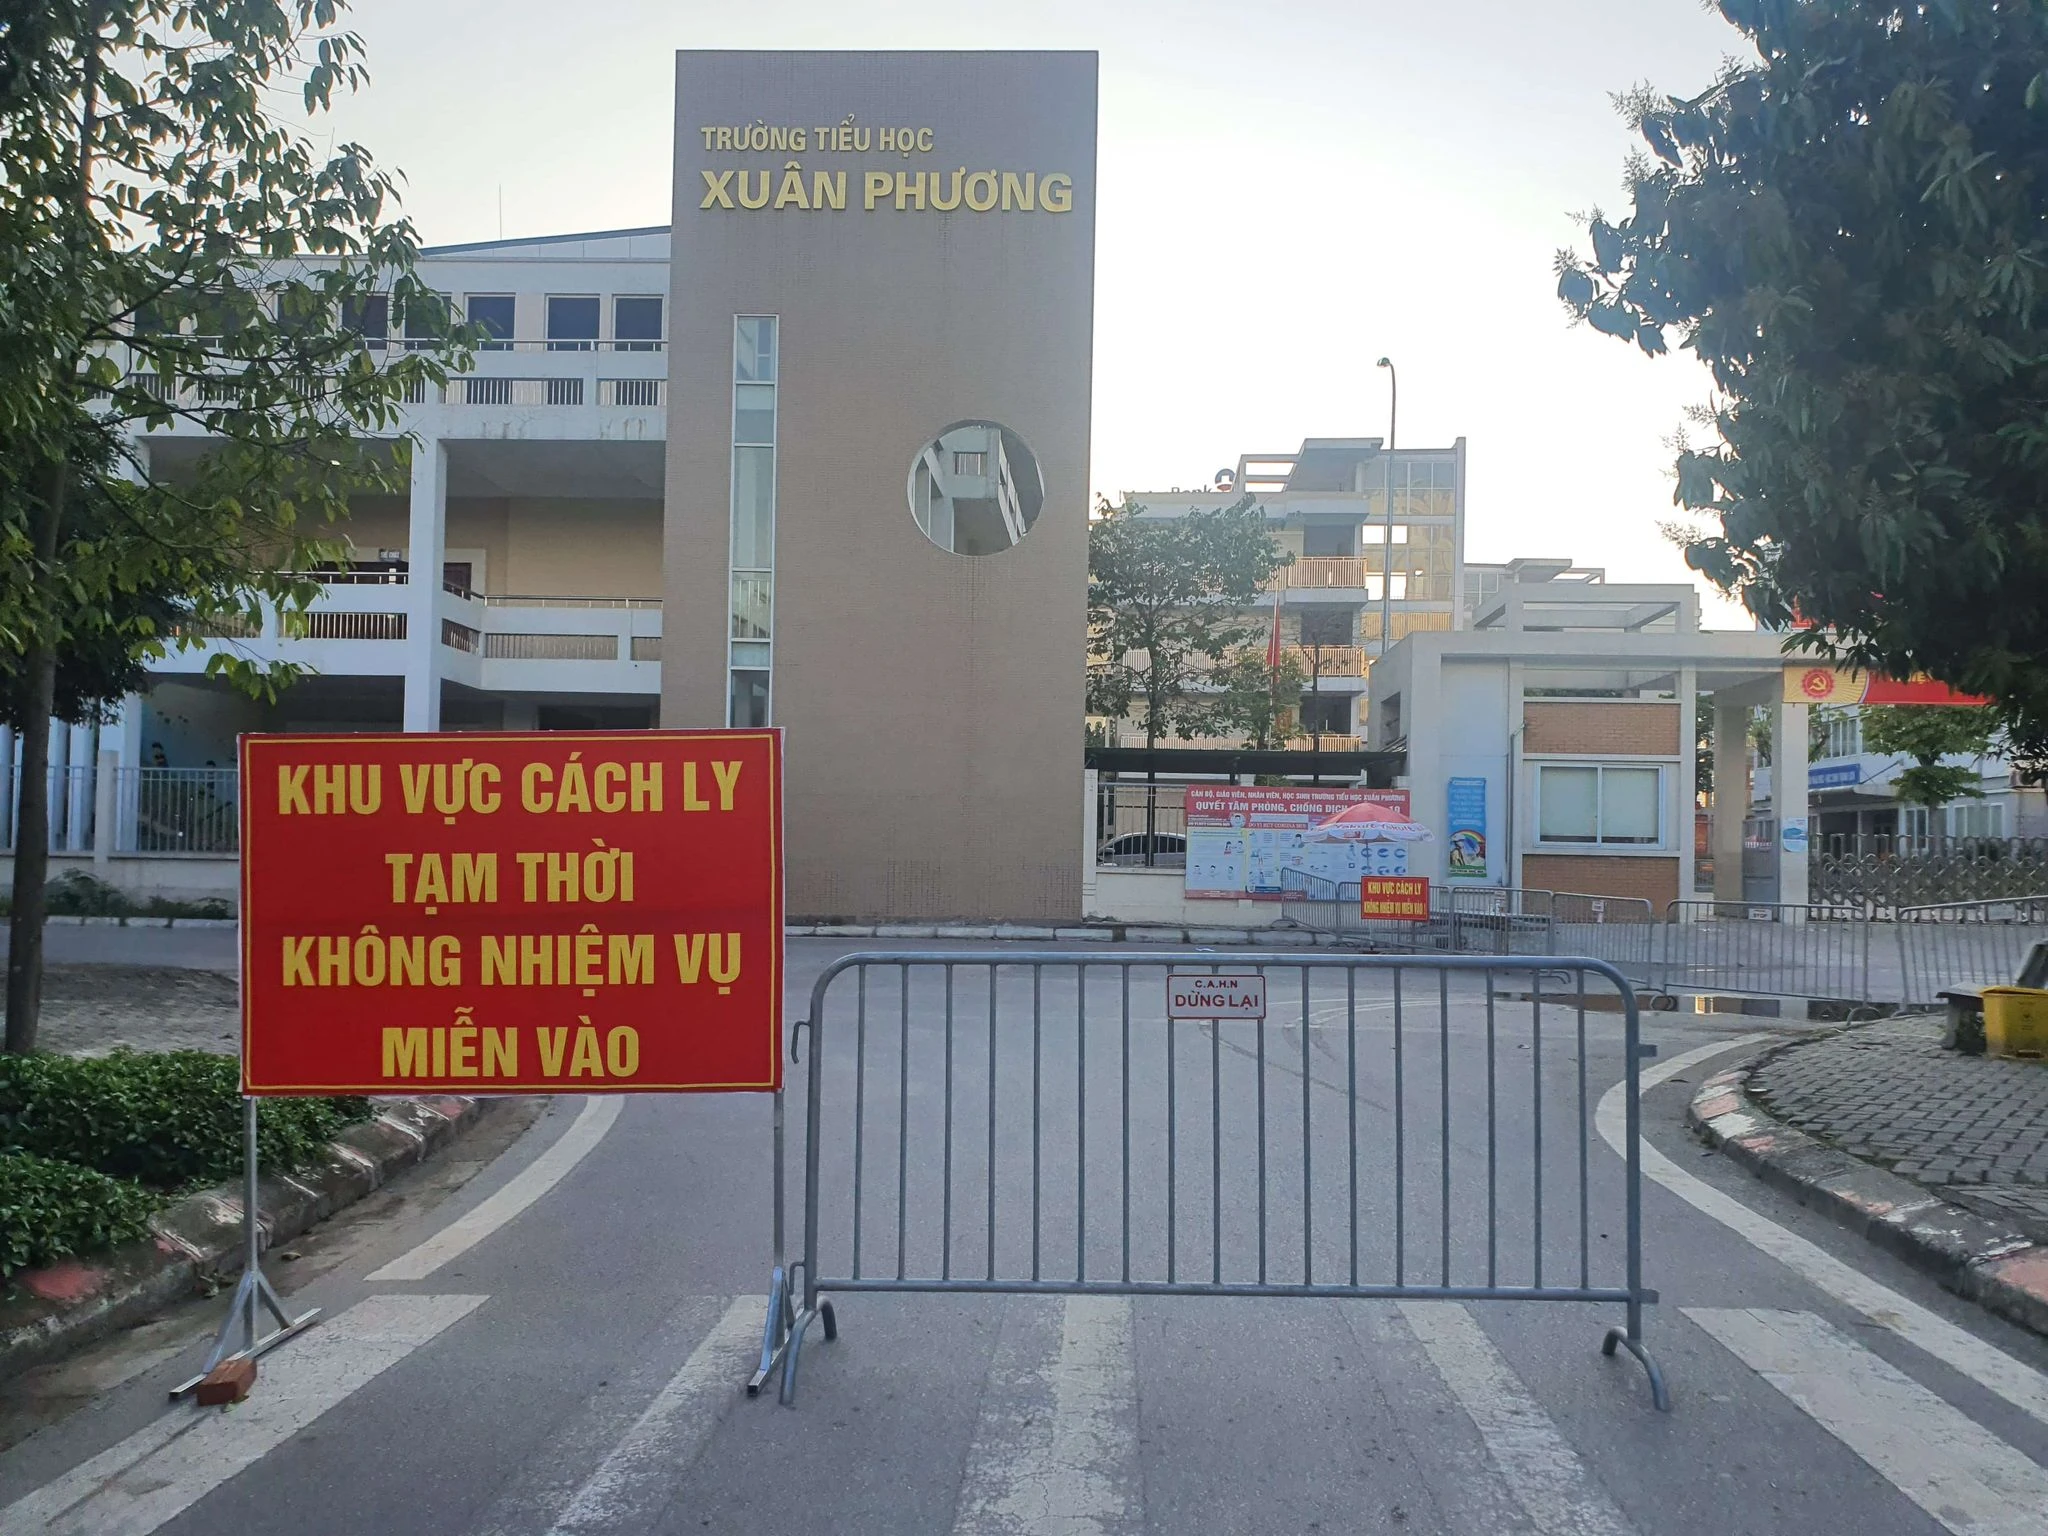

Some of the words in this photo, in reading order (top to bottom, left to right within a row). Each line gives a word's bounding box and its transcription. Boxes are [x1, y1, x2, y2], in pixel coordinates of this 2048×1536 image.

[701, 119, 807, 152] TRƯỜNG
[815, 113, 871, 152] TIỂU
[879, 127, 934, 157] HỌC
[699, 161, 847, 210] XUÂN
[864, 166, 1073, 213] PHƯƠNG
[278, 763, 382, 815] KHU
[399, 758, 501, 825] VỰC
[521, 751, 664, 814] CÁCH
[683, 760, 743, 812] LY
[1196, 799, 1225, 811] QUYẾT
[1228, 801, 1248, 811] TÂM
[1290, 801, 1322, 813] CHỐNG
[385, 852, 498, 915] TẠM
[516, 838, 634, 903] THỜI
[1368, 881, 1380, 894] KHU
[1382, 881, 1395, 898] VỰC
[1396, 880, 1413, 895] CÁCH
[1415, 882, 1421, 895] LY
[282, 924, 462, 987] KHÔNG
[481, 923, 655, 997] NHIỆM
[673, 932, 741, 995] VỤ
[1195, 980, 1238, 988] C.A.H.N
[1175, 990, 1225, 1007] DỪNG
[1228, 995, 1258, 1010] LẠI
[382, 1006, 518, 1078] MIỄN
[536, 1015, 640, 1078] VÀO
